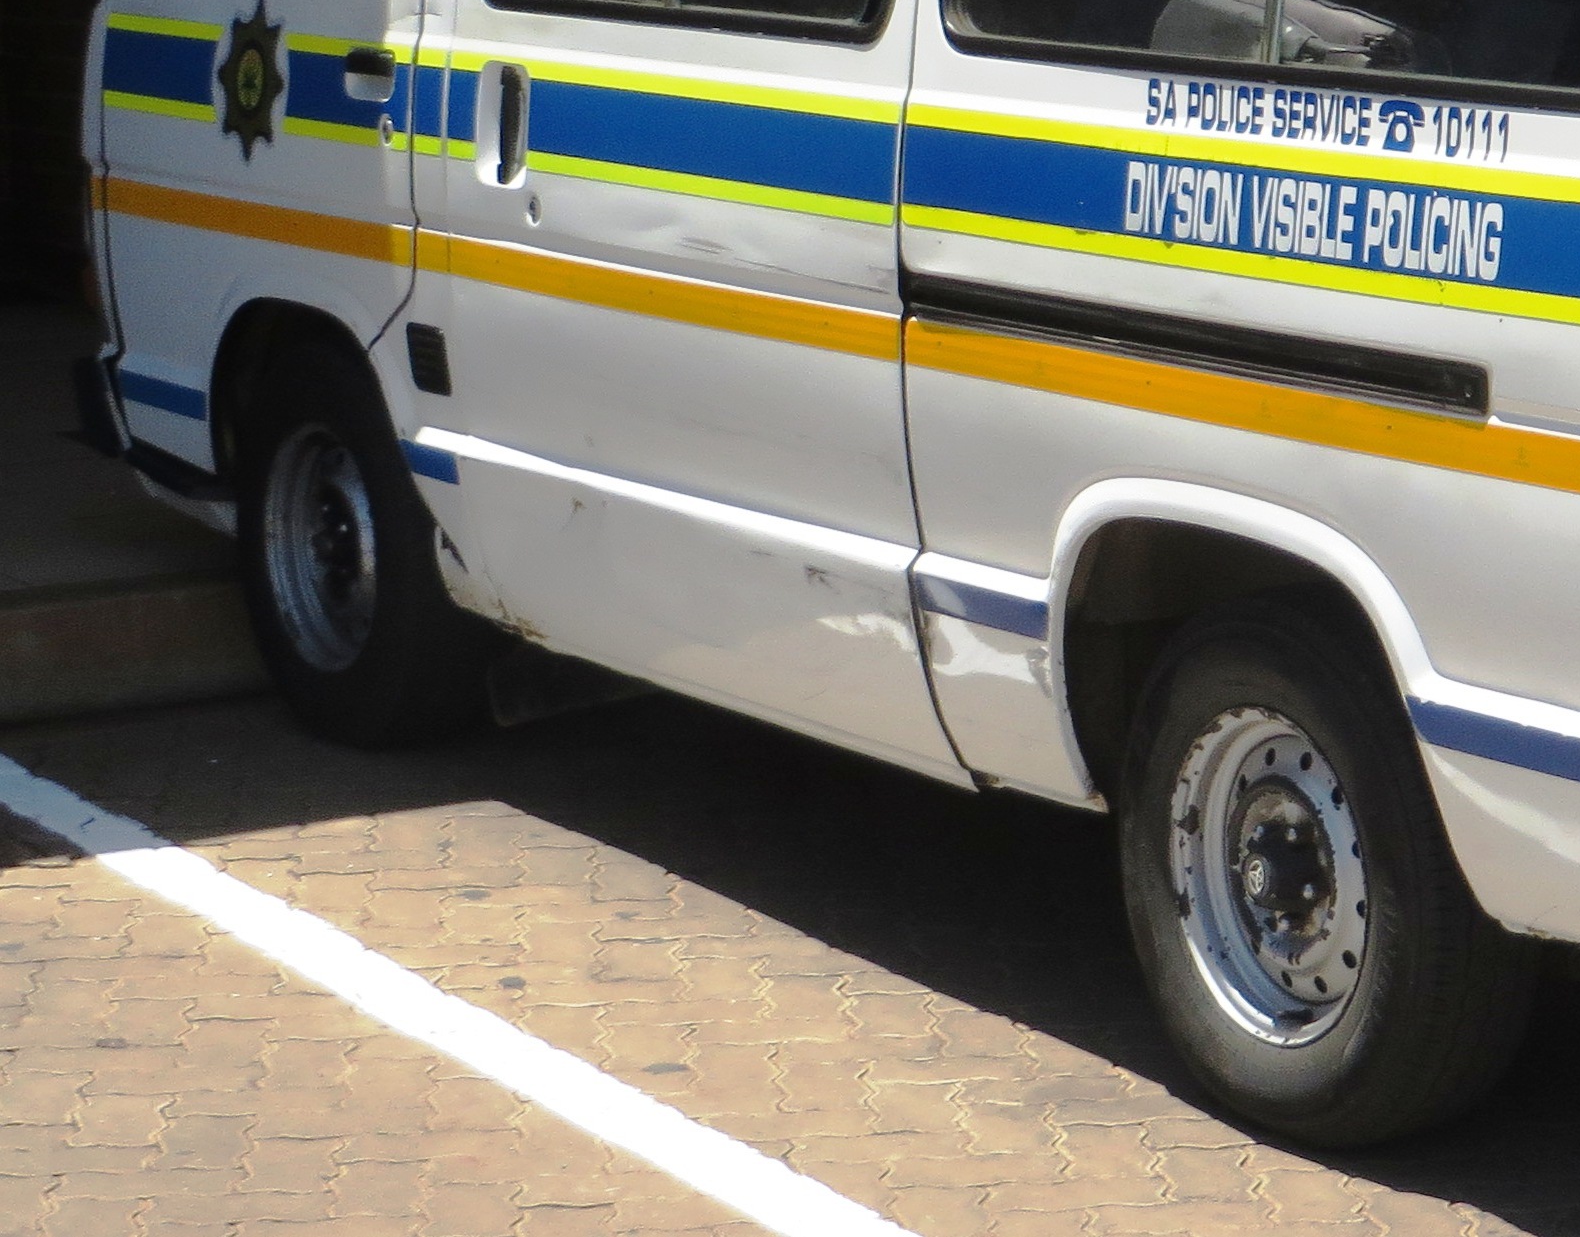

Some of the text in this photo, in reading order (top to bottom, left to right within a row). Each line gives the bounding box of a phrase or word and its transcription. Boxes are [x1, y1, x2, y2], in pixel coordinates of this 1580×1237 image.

[1146, 78, 1510, 163] SA POLICE SERVICE 10111
[1252, 175, 1358, 261] VISIBLE
[1363, 188, 1503, 281] POLICING
